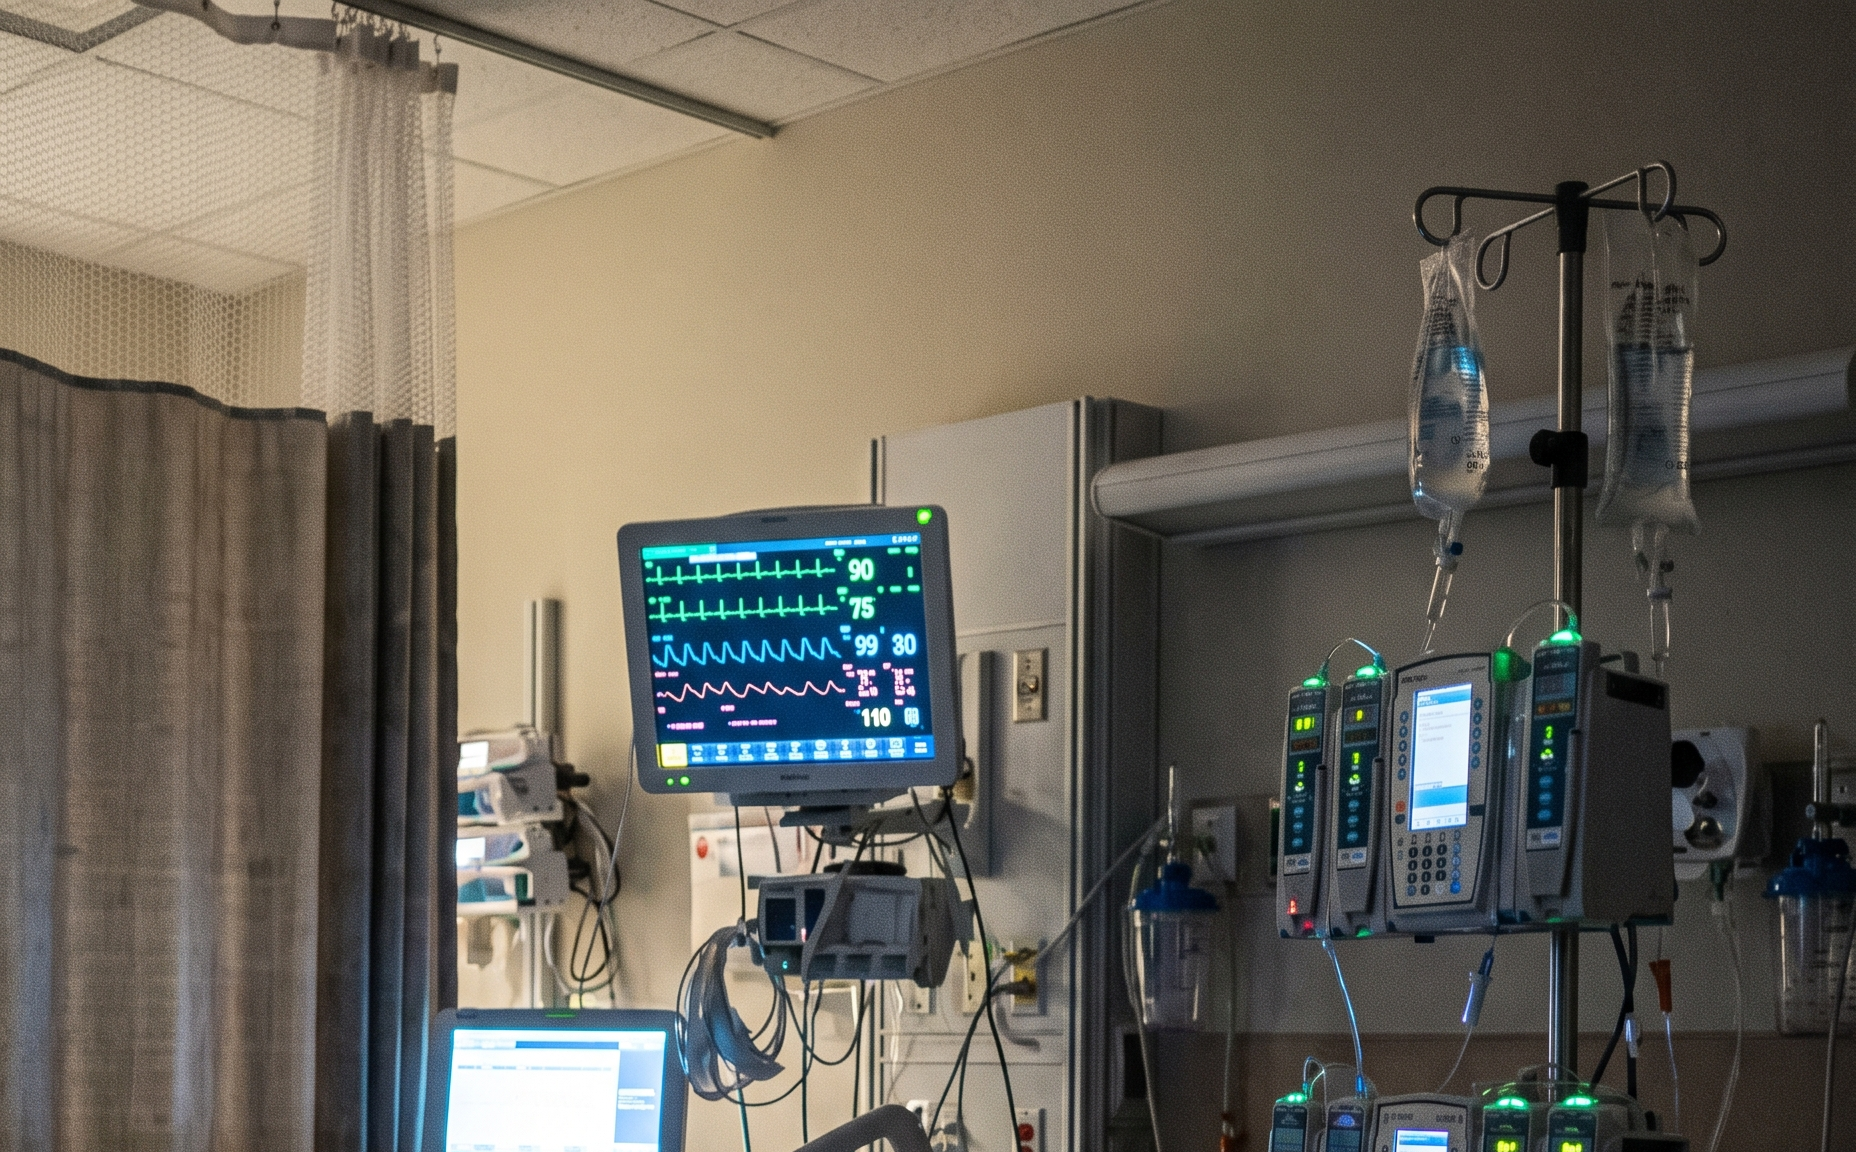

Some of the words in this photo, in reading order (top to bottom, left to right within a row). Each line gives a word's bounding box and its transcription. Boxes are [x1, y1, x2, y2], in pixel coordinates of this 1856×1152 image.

[848, 558, 874, 581] 90
[849, 596, 875, 619] 75
[854, 634, 879, 656] 99
[861, 707, 892, 727] 110
